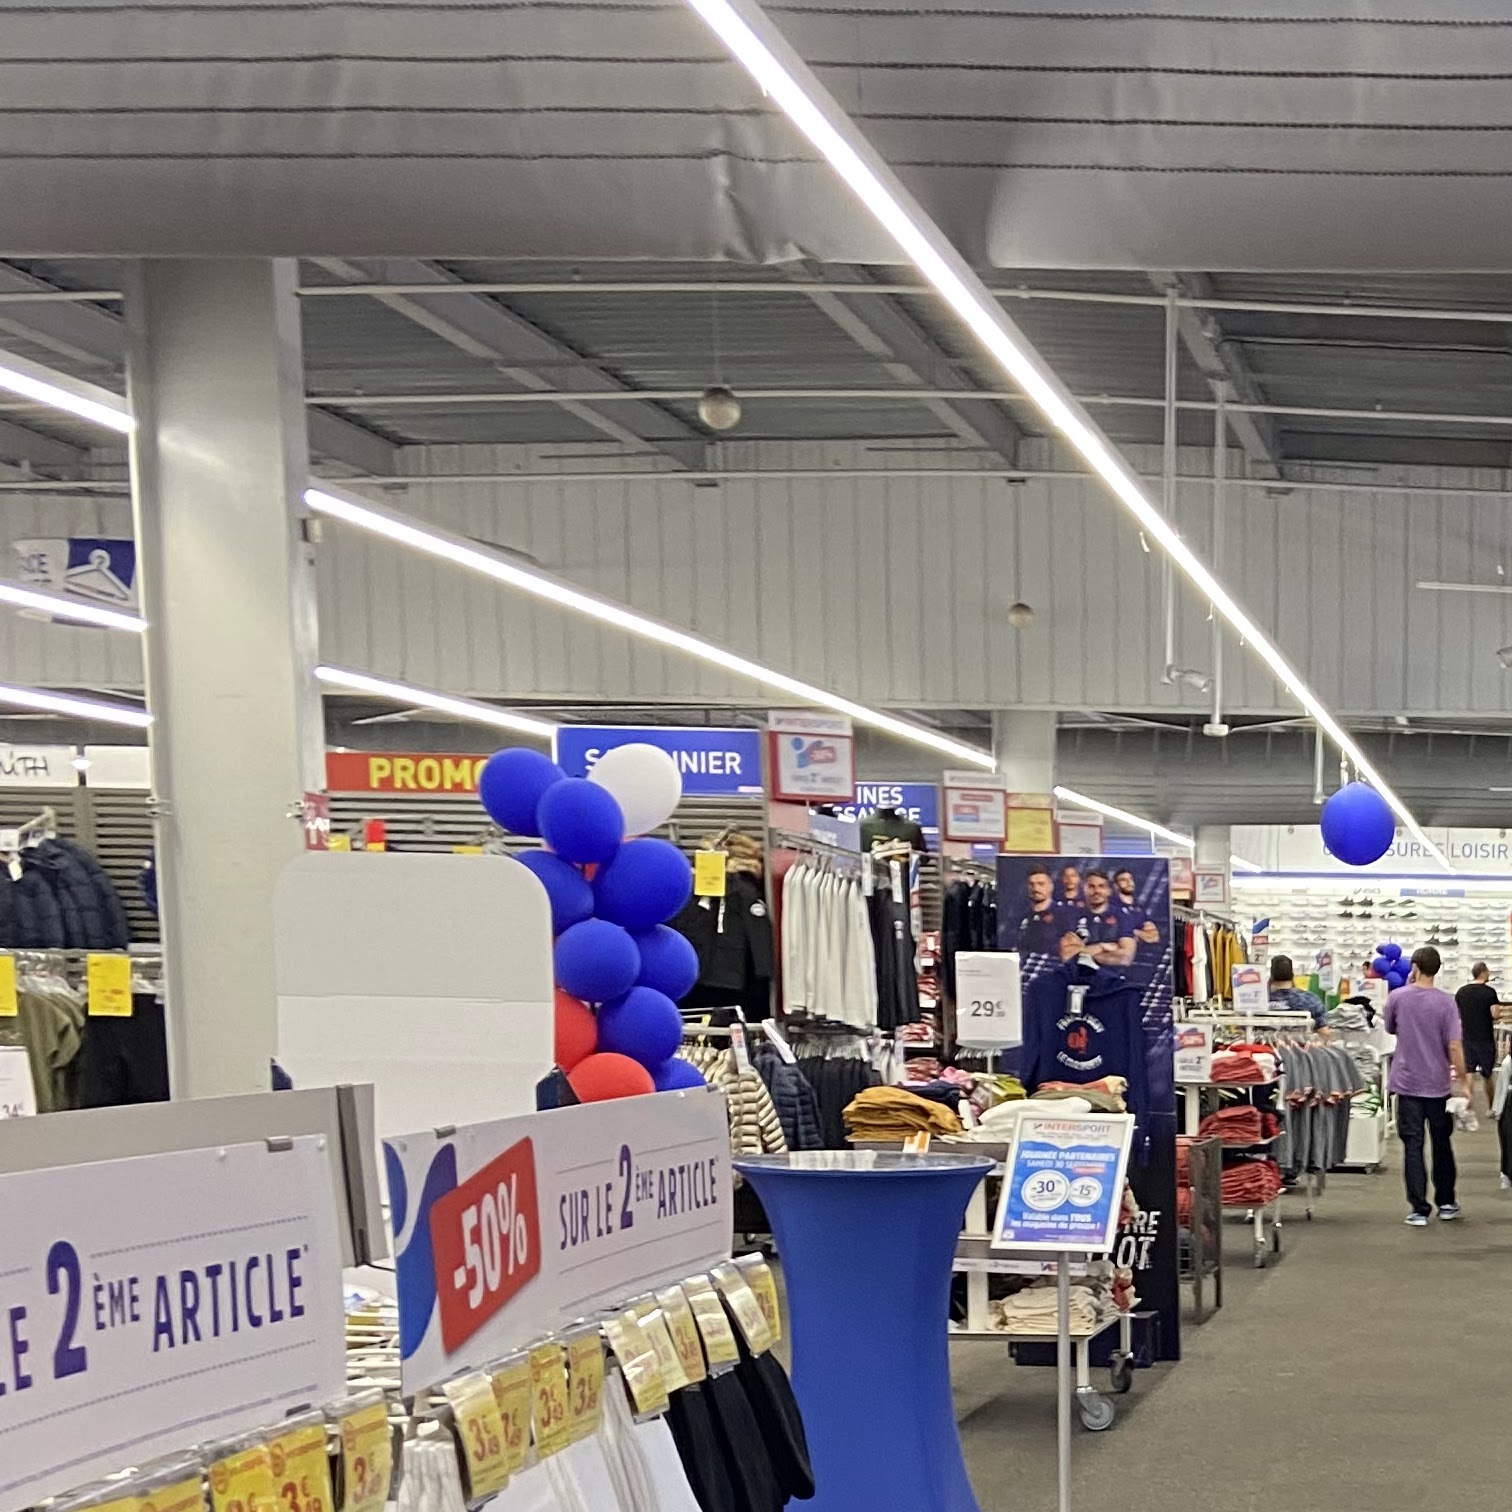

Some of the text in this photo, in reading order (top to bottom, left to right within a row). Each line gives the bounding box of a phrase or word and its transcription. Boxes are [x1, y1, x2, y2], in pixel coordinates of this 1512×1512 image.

[1451, 844, 1509, 859] LOISIR
[454, 1173, 527, 1310] -50%
[560, 1190, 590, 1250] SUR
[596, 1182, 613, 1237] LE
[657, 1158, 717, 1219] ARTICLE
